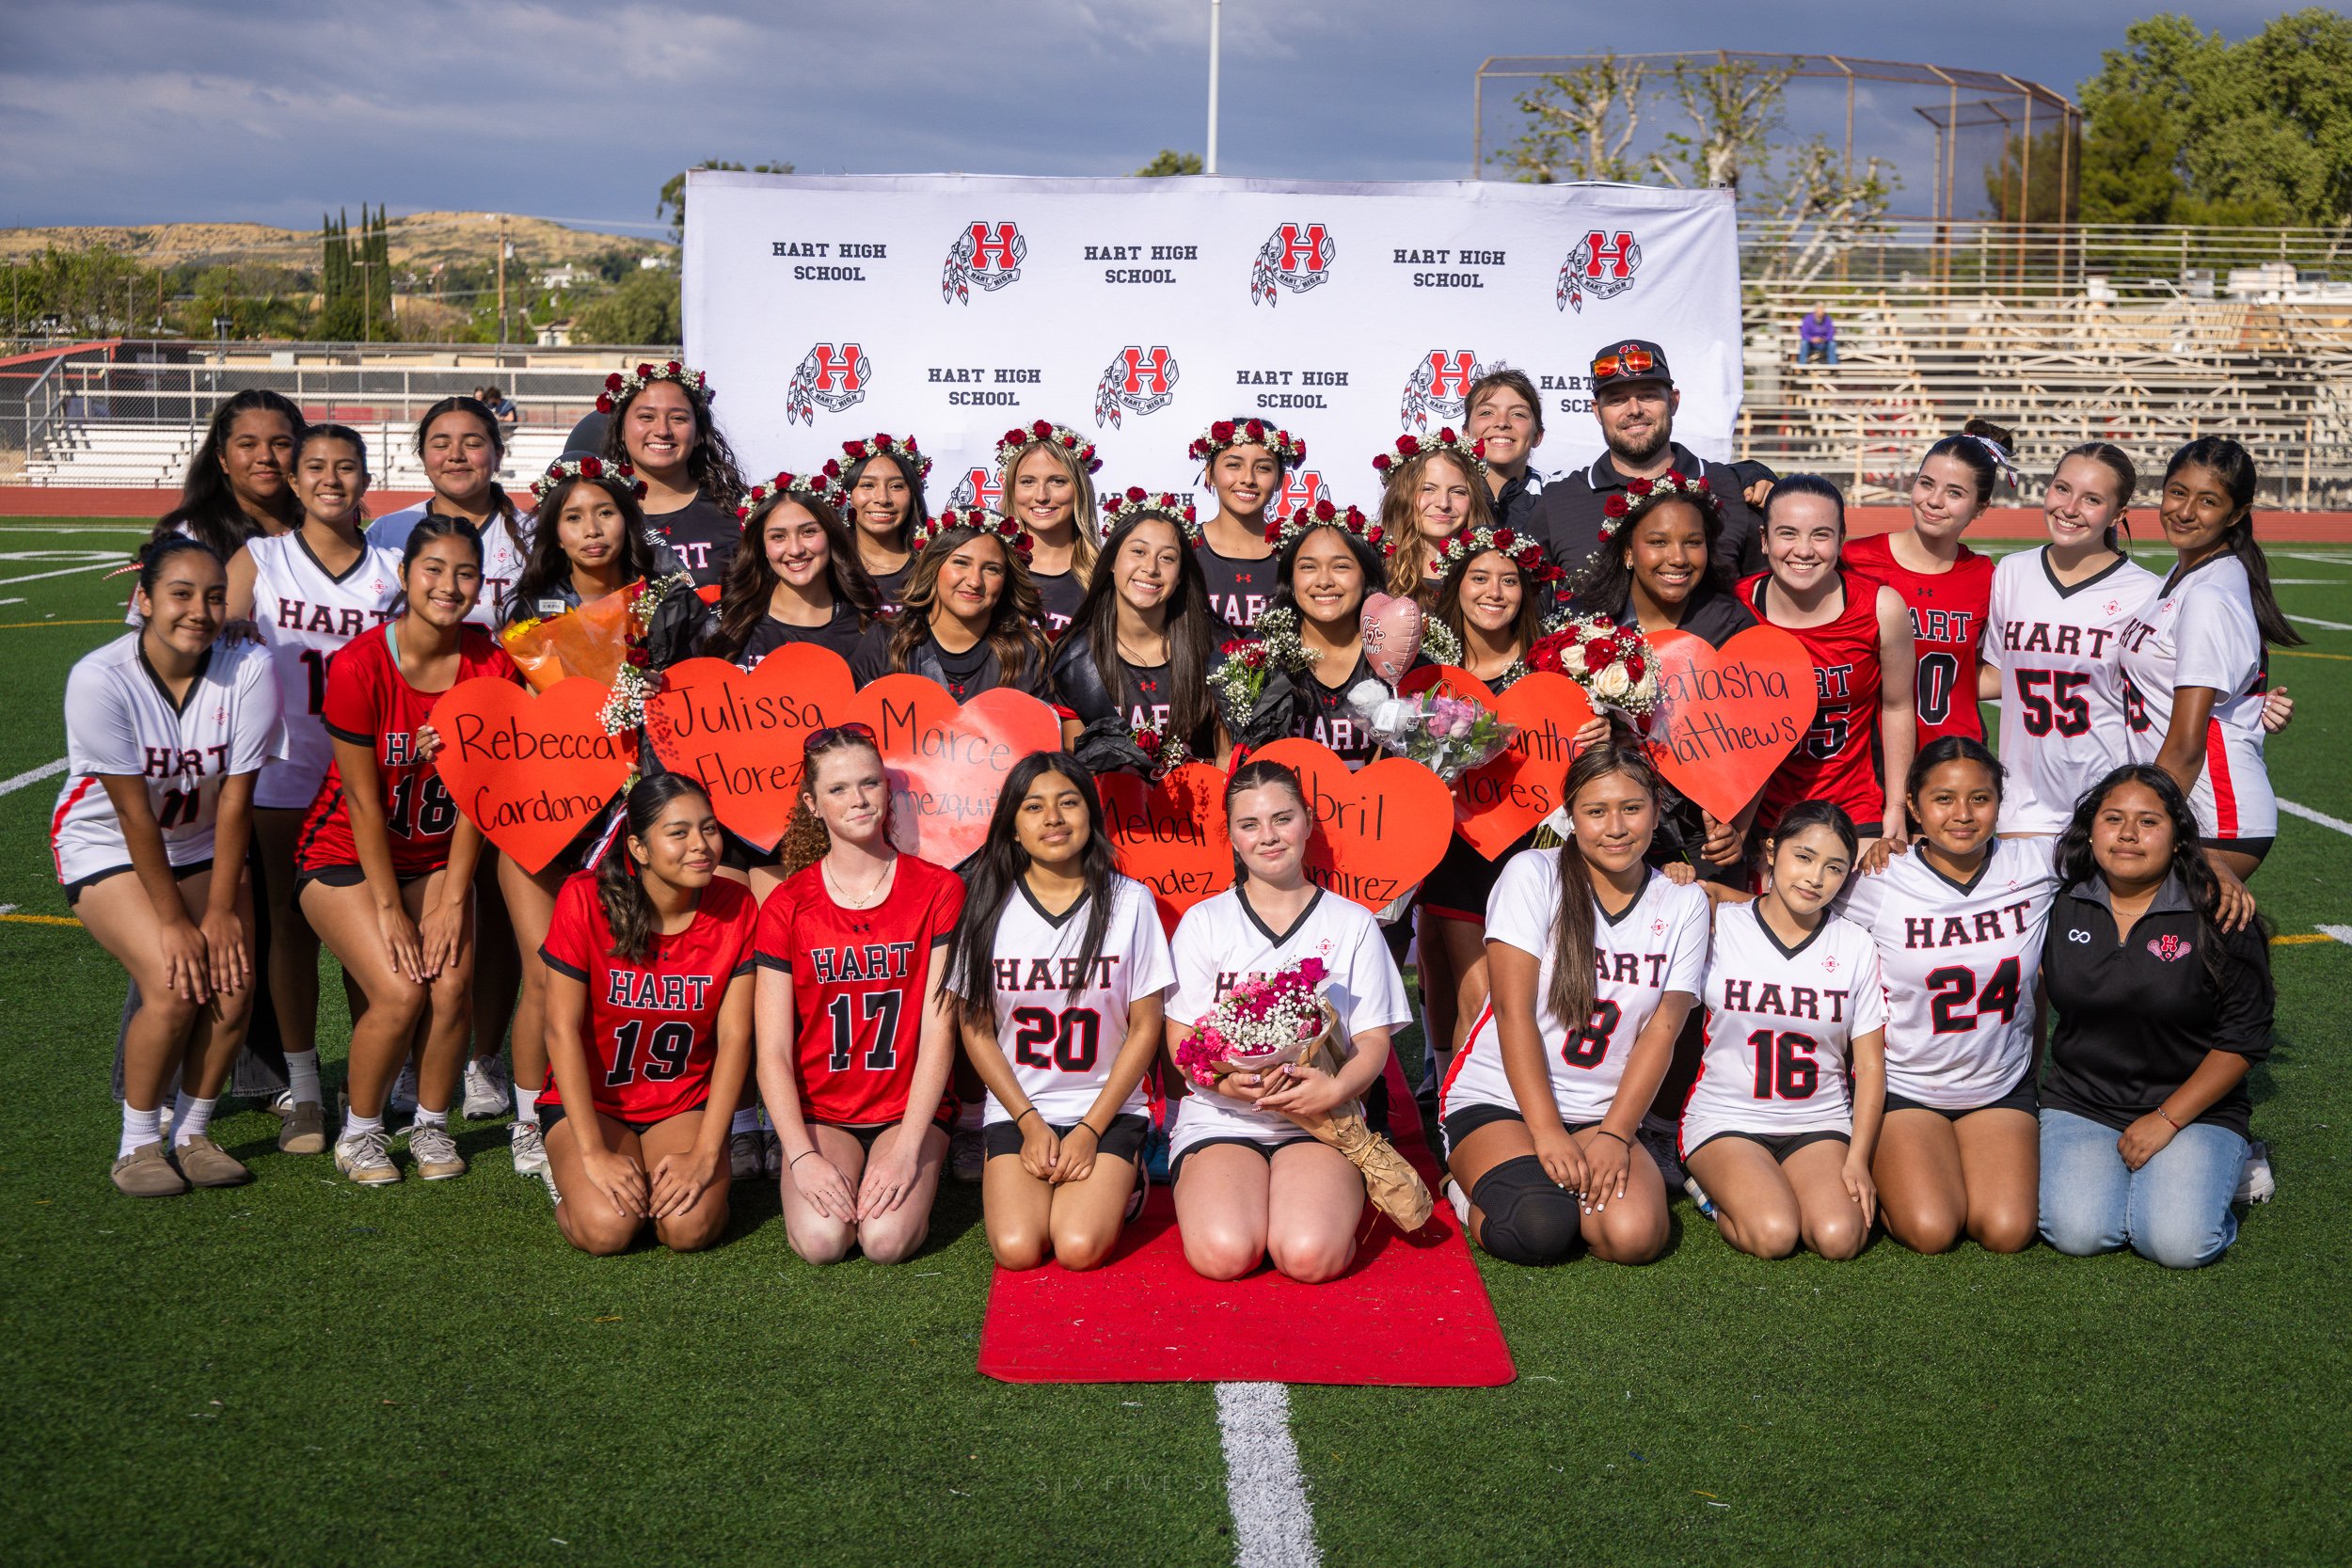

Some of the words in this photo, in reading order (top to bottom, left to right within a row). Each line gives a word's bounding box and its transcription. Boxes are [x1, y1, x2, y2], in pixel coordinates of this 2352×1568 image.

[771, 242, 830, 258] HART
[838, 244, 887, 259] HIGH
[968, 221, 1019, 271] H
[1084, 245, 1142, 261] HART
[1151, 245, 1198, 261] HIGH
[1277, 223, 1327, 273] H
[1393, 249, 1451, 264] HART
[1459, 249, 1506, 265] HIGH
[1583, 230, 1635, 279] H
[794, 265, 866, 281] SCHOOL
[1104, 269, 1176, 284] SCHOOL
[1413, 273, 1484, 288] SCHOOL
[812, 343, 864, 392] H
[928, 368, 985, 383] HART
[993, 369, 1041, 384] HIGH
[1120, 346, 1171, 395] H
[1236, 370, 1293, 386] HART
[1302, 371, 1349, 387] HIGH
[1426, 350, 1477, 399] H
[948, 391, 1020, 406] SCHOOL
[1257, 393, 1327, 409] SCHOOL
[1560, 399, 1594, 413] SCH
[278, 597, 393, 637] HART
[1908, 607, 1973, 643] ART
[2004, 620, 2114, 659] HART
[1663, 657, 1789, 703] atasha
[1813, 663, 1853, 700] RT
[671, 681, 826, 737] Julissa
[2015, 668, 2091, 738] 55
[456, 713, 617, 763] Rebecca
[882, 697, 1010, 771] Marce
[1797, 704, 1852, 760] 5
[143, 743, 229, 779] HART
[695, 752, 805, 797] Florez
[387, 773, 459, 840] 18
[474, 786, 603, 832] Cardona
[1463, 772, 1549, 814] lores
[1136, 868, 1221, 896] ndez
[1904, 899, 2032, 950] HART
[2161, 934, 2179, 953] H
[811, 941, 915, 984] HART
[993, 955, 1120, 991] HART
[1594, 946, 1667, 989] ART
[607, 969, 713, 1011] HART
[1724, 978, 1850, 1023] HART
[1925, 954, 2021, 1036] 24
[604, 1019, 695, 1087] 19
[828, 990, 903, 1072] 17
[1011, 1006, 1102, 1073] 20
[1561, 998, 1623, 1070] 8
[1747, 1028, 1820, 1101] 16
